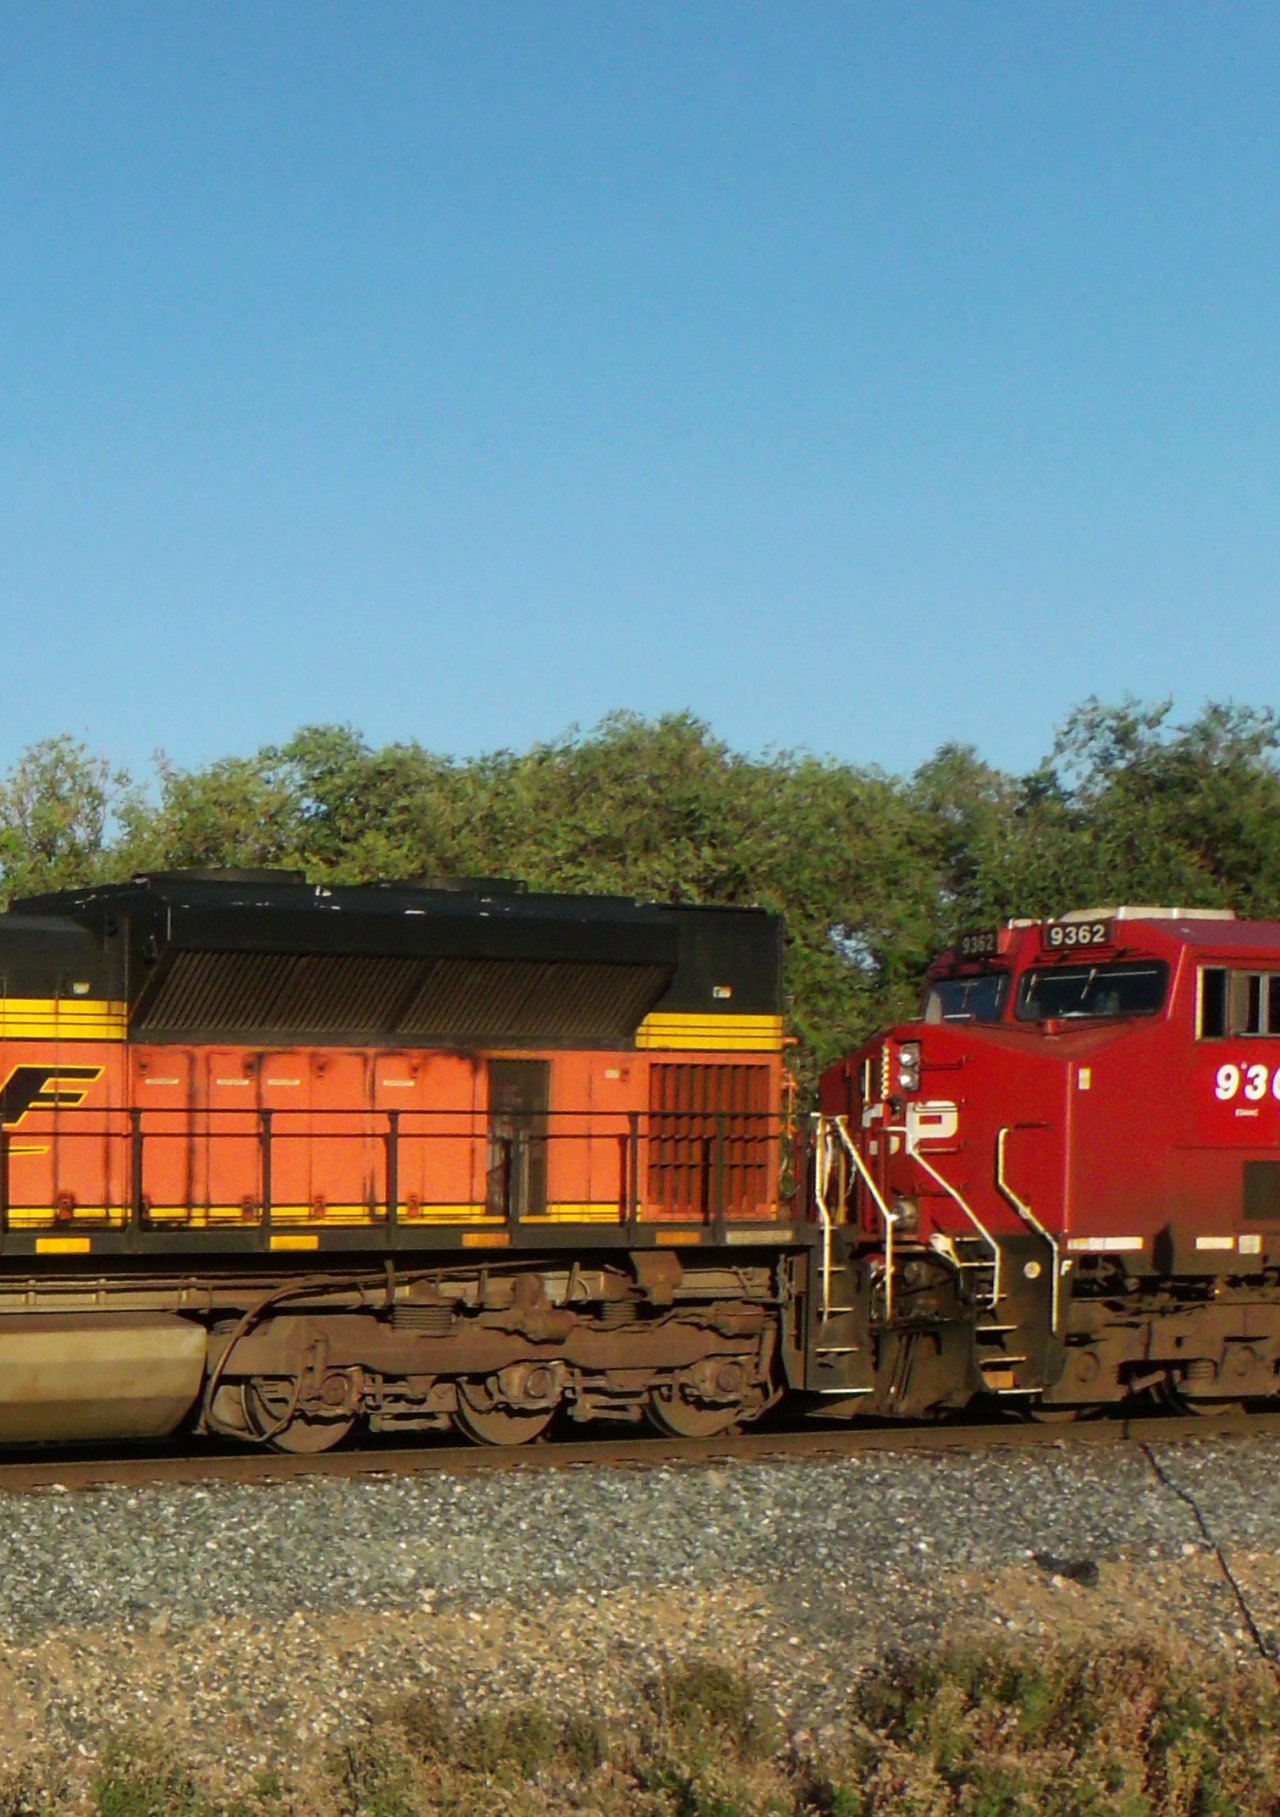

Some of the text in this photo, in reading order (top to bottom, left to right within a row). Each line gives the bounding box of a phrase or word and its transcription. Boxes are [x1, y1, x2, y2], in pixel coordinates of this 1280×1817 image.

[962, 933, 995, 954] 9362
[1050, 924, 1106, 946] 9362
[1060, 1260, 1073, 1276] F
